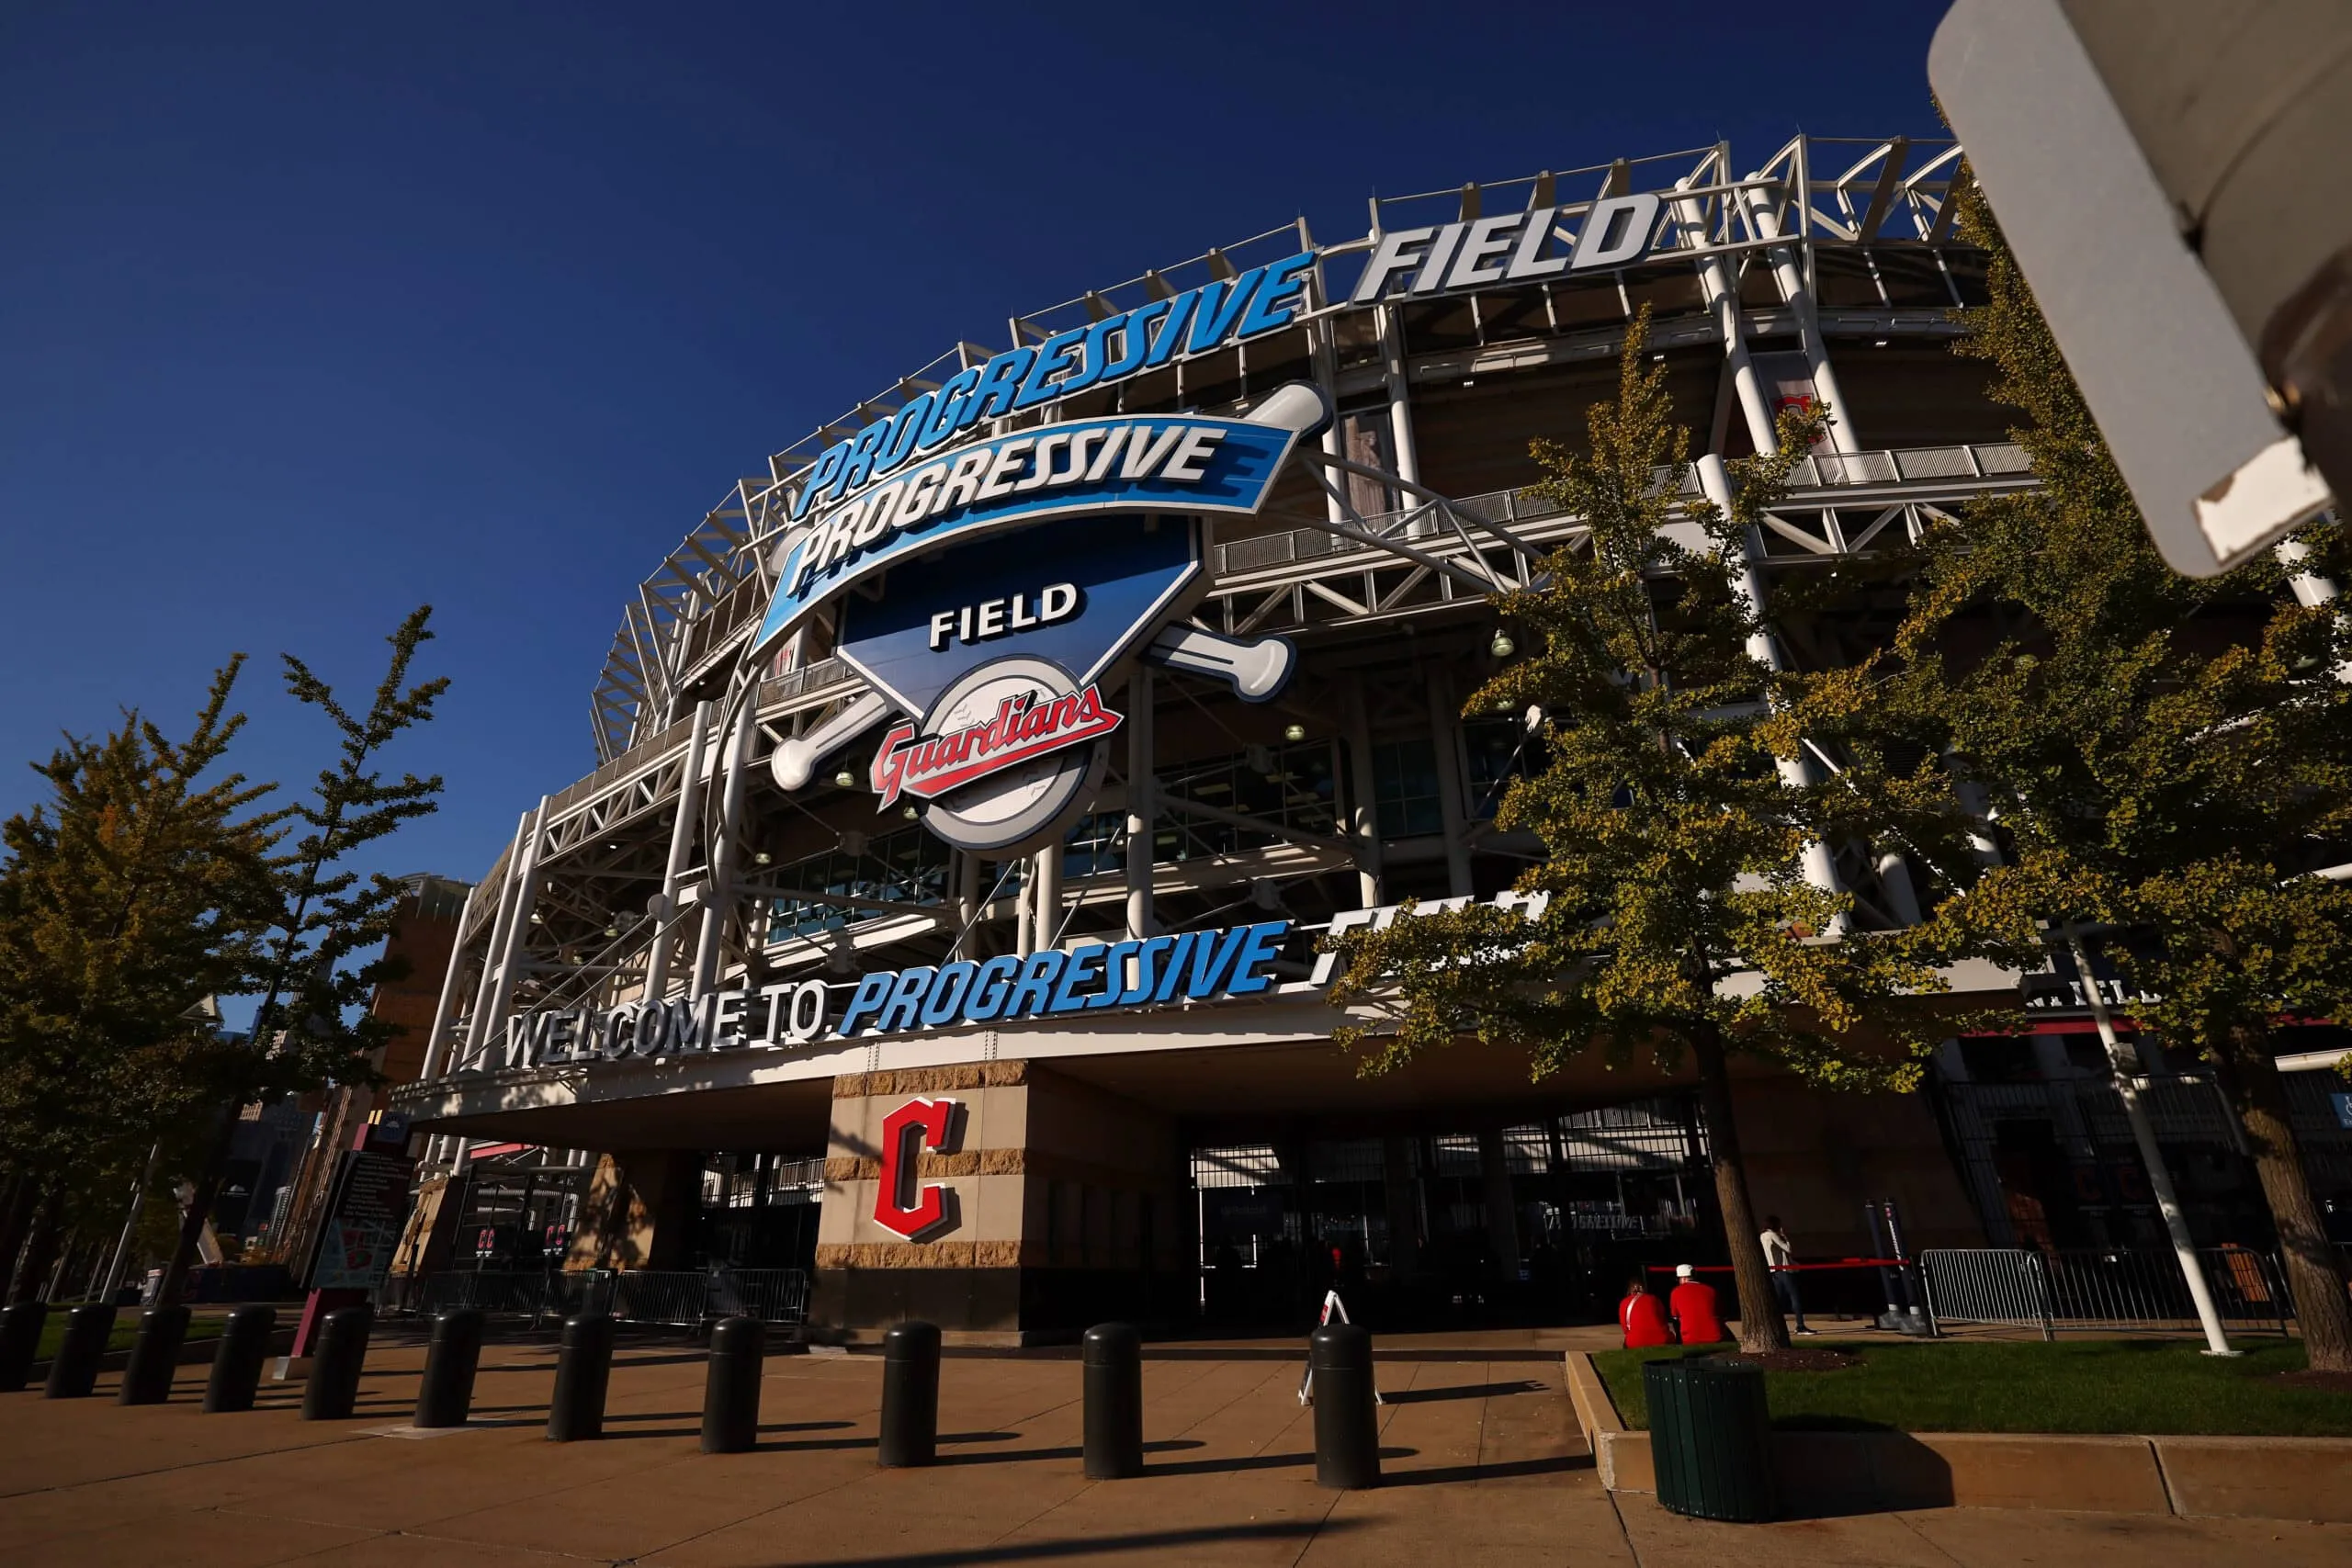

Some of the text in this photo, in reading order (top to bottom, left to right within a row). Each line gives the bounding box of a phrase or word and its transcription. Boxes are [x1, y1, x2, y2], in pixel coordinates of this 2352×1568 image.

[796, 192, 1665, 520] PROGRESSIVE FIELD
[787, 427, 1227, 596] PROGRESSIVE
[929, 583, 1078, 649] FIELD
[870, 685, 1125, 814] Guardians
[505, 992, 746, 1069] WELCOME
[761, 979, 831, 1042] TO
[838, 920, 1294, 1036] PROGRESSIVE
[874, 1098, 958, 1240] C
